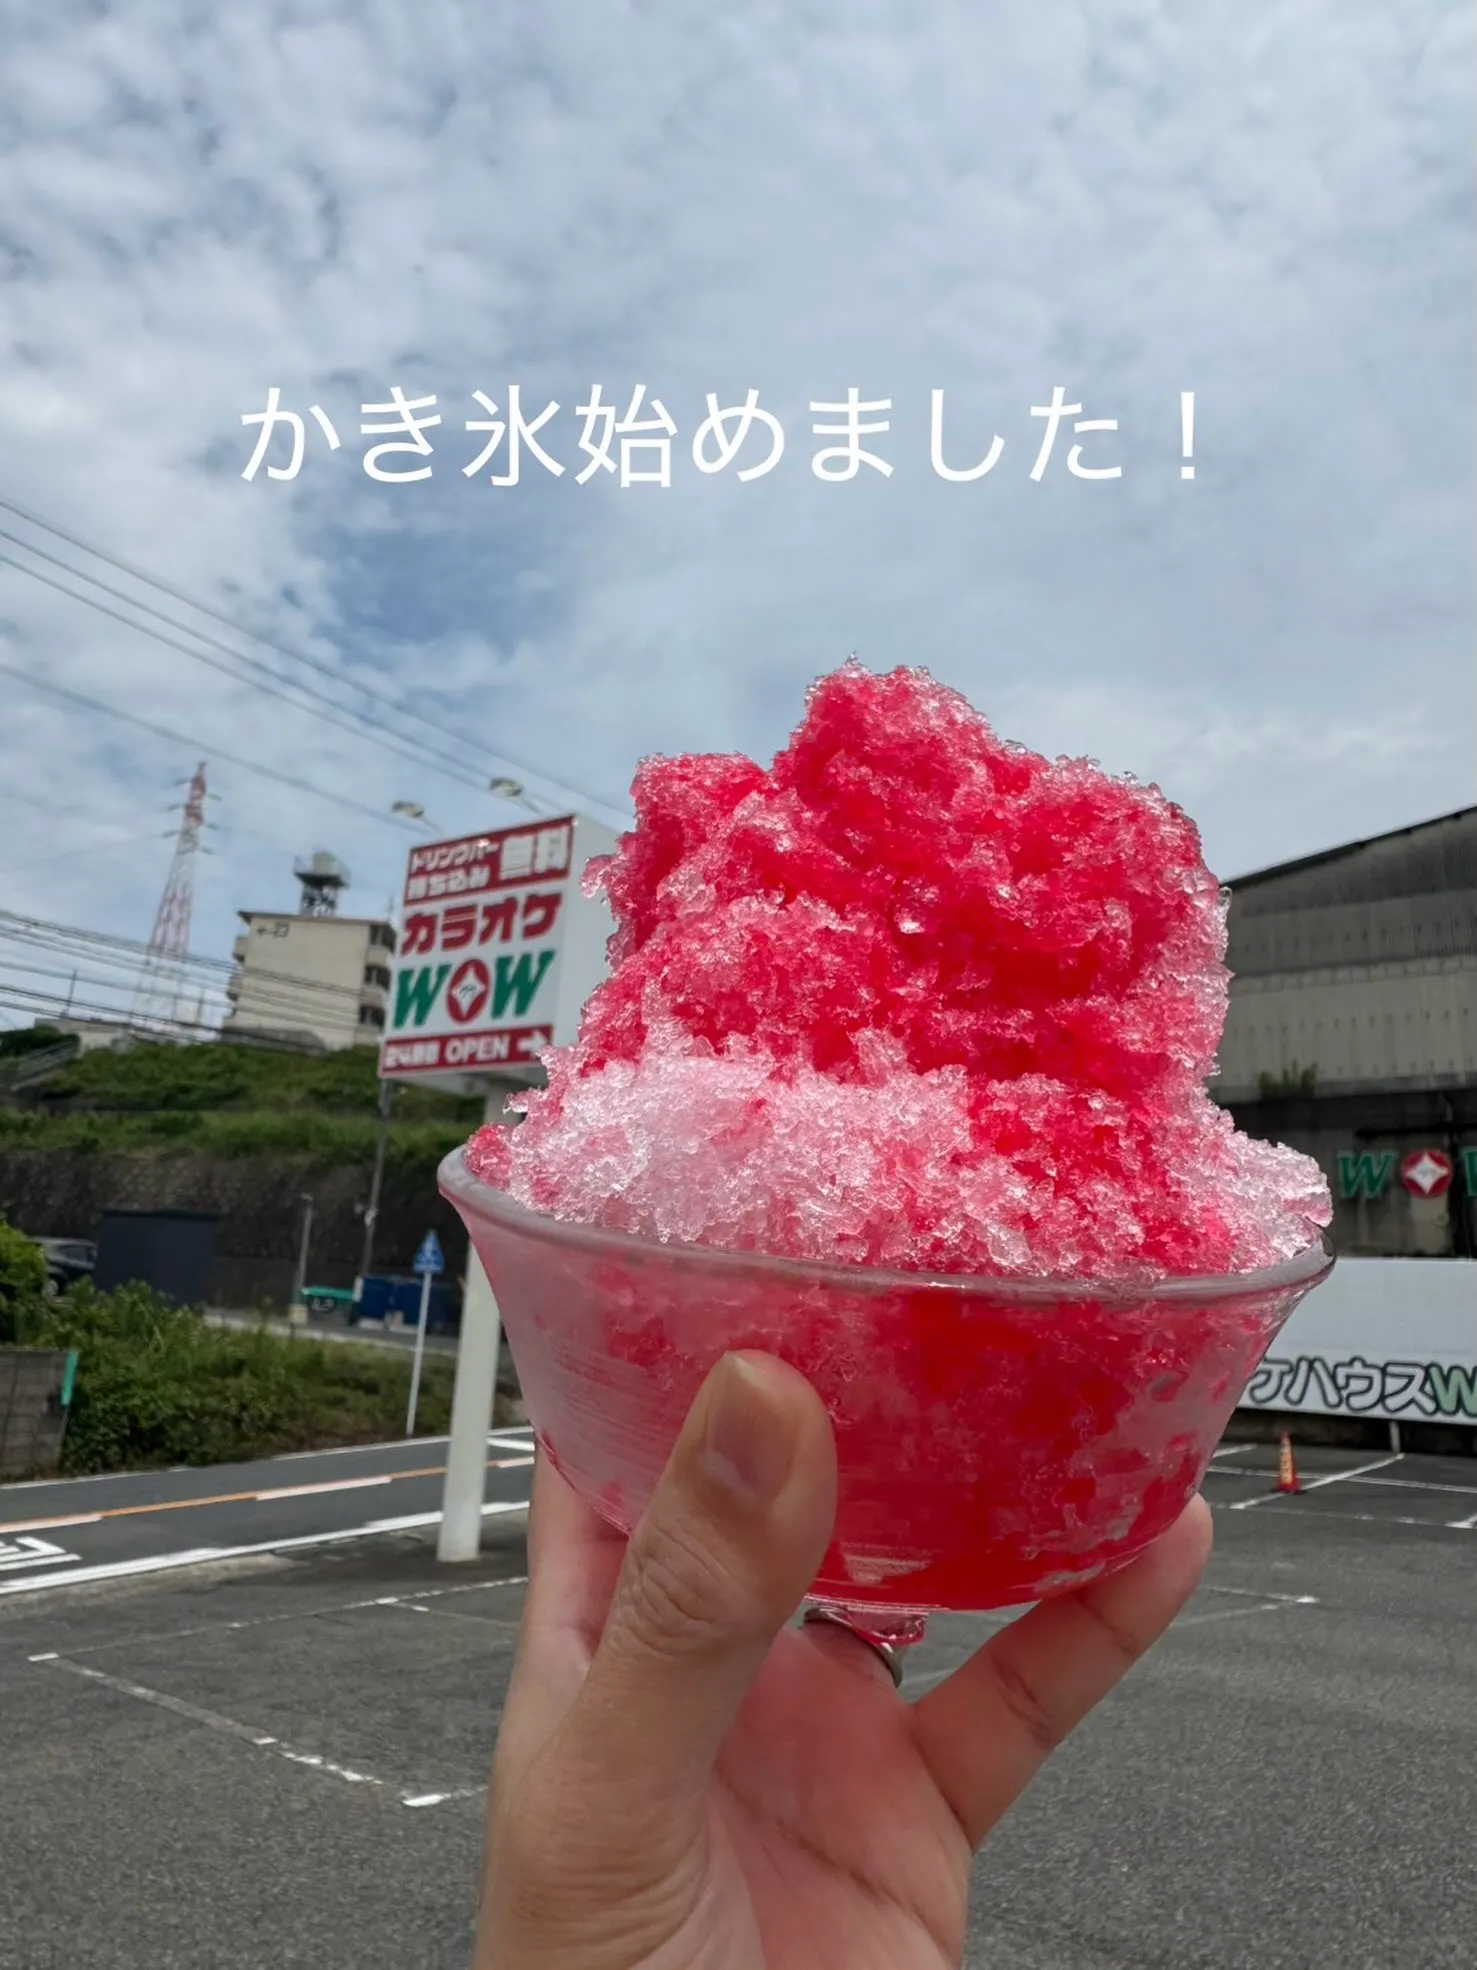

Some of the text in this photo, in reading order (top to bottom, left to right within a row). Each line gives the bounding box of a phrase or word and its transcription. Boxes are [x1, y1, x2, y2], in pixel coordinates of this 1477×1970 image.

[401, 893, 562, 957] カラオケ
[394, 949, 556, 1029] WOW
[445, 1034, 510, 1064] OPEN
[1337, 1147, 1477, 1199] WO
